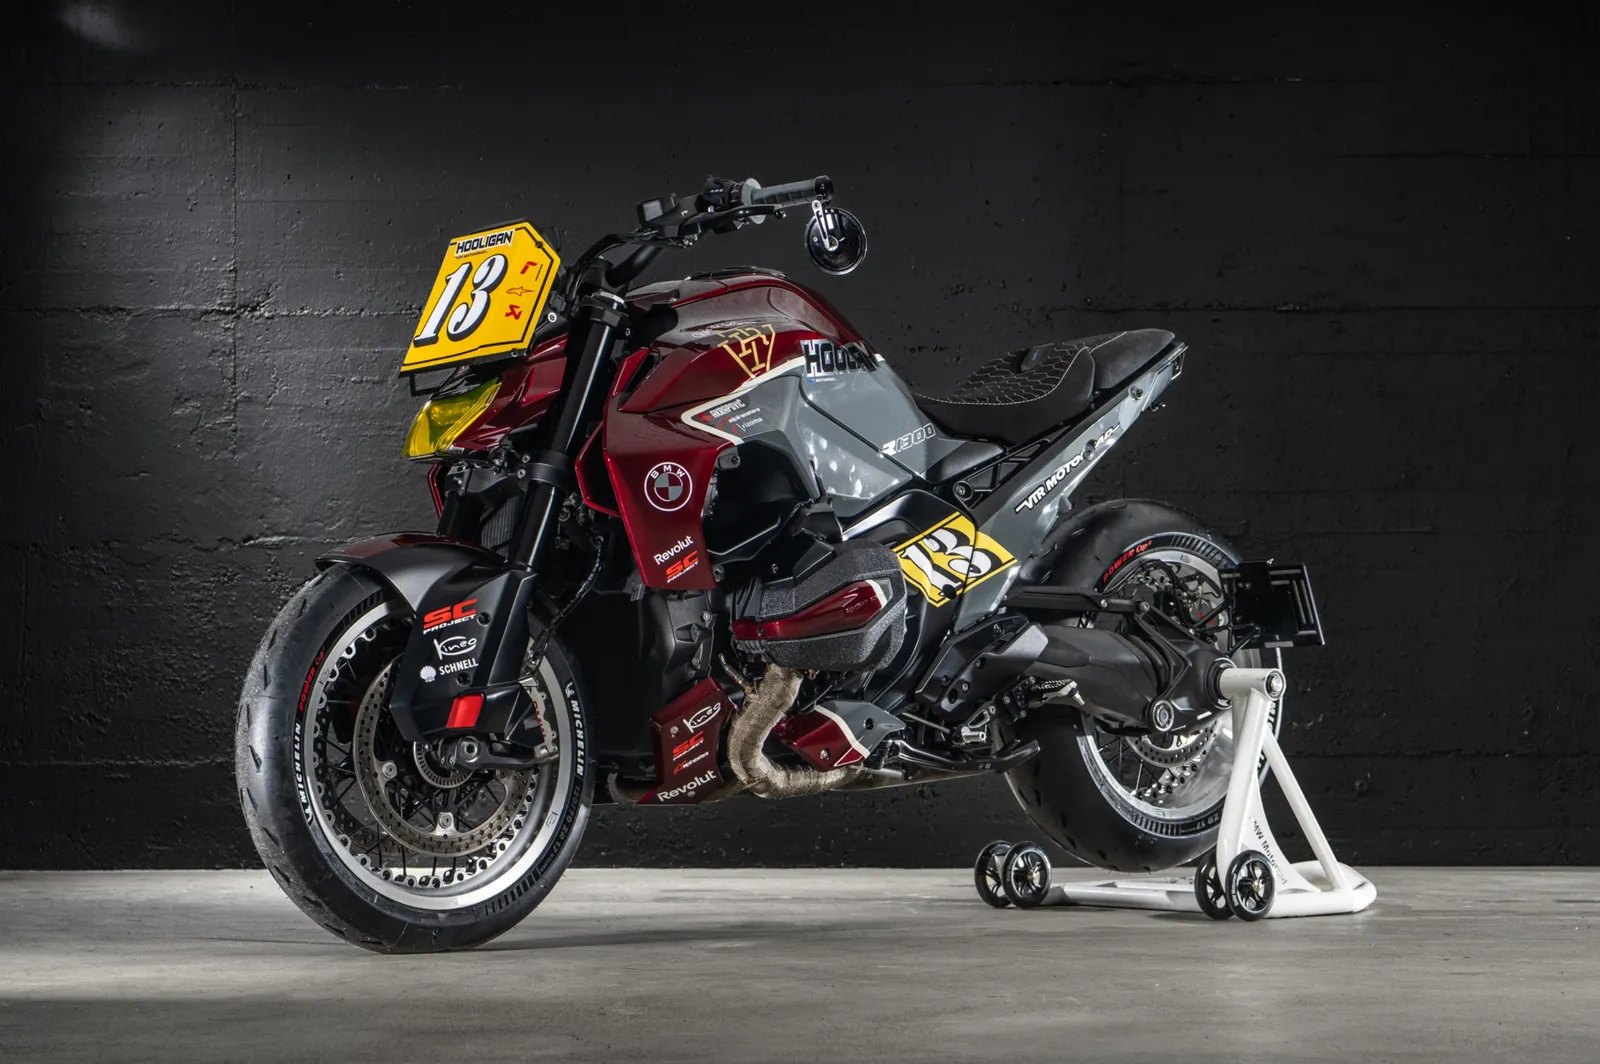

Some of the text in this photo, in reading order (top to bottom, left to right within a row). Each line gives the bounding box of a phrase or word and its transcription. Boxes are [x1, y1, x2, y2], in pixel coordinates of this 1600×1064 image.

[456, 231, 513, 254] HOOLIGAN
[413, 254, 508, 348] 13
[1014, 424, 1120, 513] VTR MOTOAD
[654, 535, 693, 565] Revolut
[665, 550, 699, 580] SC
[900, 526, 1003, 597] 13
[667, 561, 699, 583] PROJECT
[1103, 549, 1134, 583] POWER
[423, 598, 478, 629] SC
[423, 614, 477, 635] PROJECT
[439, 658, 479, 675] SCHNELL
[299, 667, 315, 711] POWER
[571, 700, 584, 776] MICHELIN
[673, 730, 703, 758] SC
[294, 722, 307, 803] MICHELIN
[657, 770, 716, 801] Revolut
